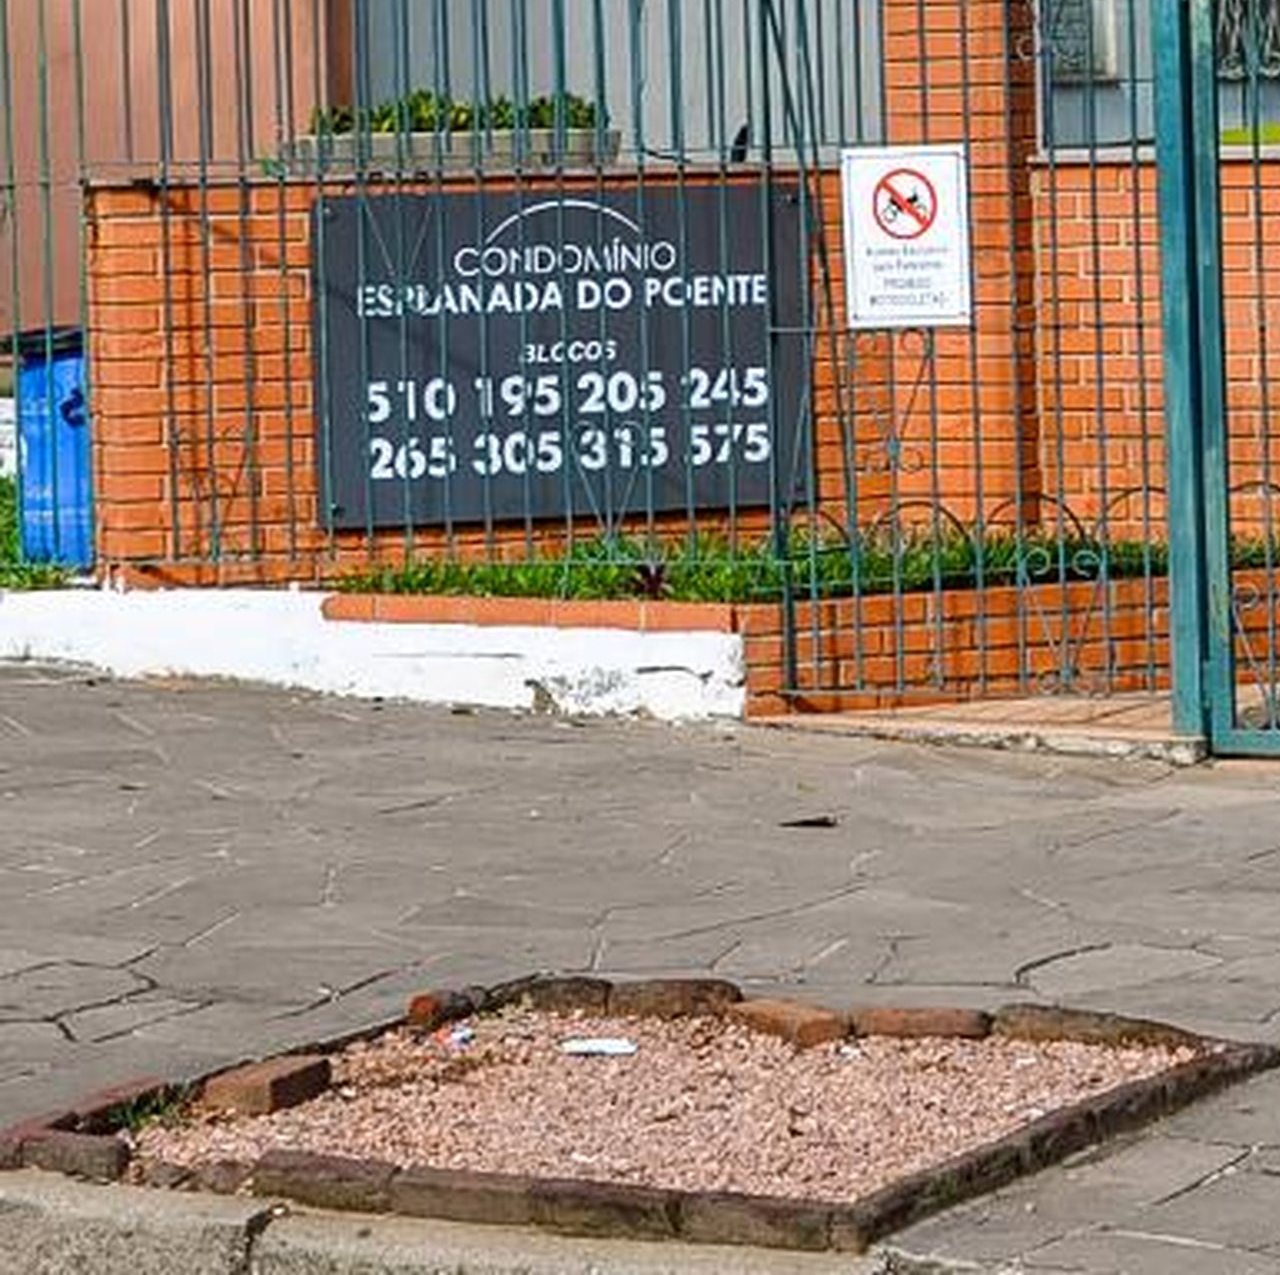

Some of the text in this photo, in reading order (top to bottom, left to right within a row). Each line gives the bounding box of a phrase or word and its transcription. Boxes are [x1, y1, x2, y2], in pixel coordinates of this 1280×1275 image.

[454, 237, 676, 276] CONDOMÍNIO
[358, 275, 768, 317] ESPLANADA DO POENTE
[521, 340, 617, 365] BLOCOS
[363, 367, 769, 422] 510 195 205 245
[370, 423, 772, 479] 265 305 315 575
